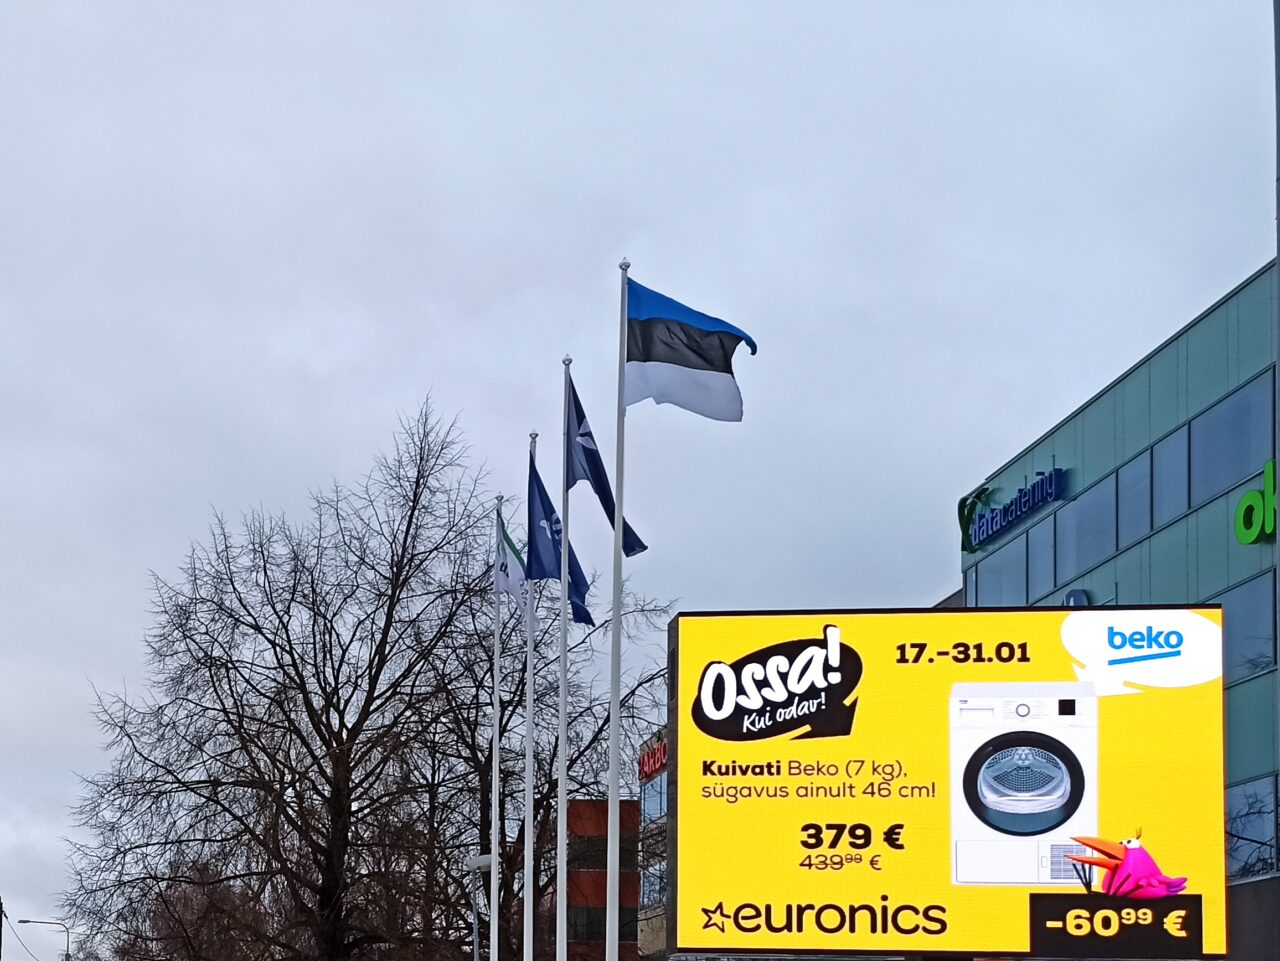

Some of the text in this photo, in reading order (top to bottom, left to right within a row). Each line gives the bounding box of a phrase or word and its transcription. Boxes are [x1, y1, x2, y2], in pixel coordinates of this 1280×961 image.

[971, 470, 1058, 546] datacatering
[1107, 626, 1184, 650] beko
[895, 641, 1031, 664] 17.-31.01
[700, 626, 842, 720] Ossa!
[742, 691, 827, 733] Kui odav!
[701, 760, 908, 782] Kuivati Beko (7 kg),
[701, 781, 936, 804] sügavus ainult 46 cm!
[799, 822, 905, 850] 379 €
[732, 895, 948, 936] euronics
[1163, 909, 1188, 938] €
